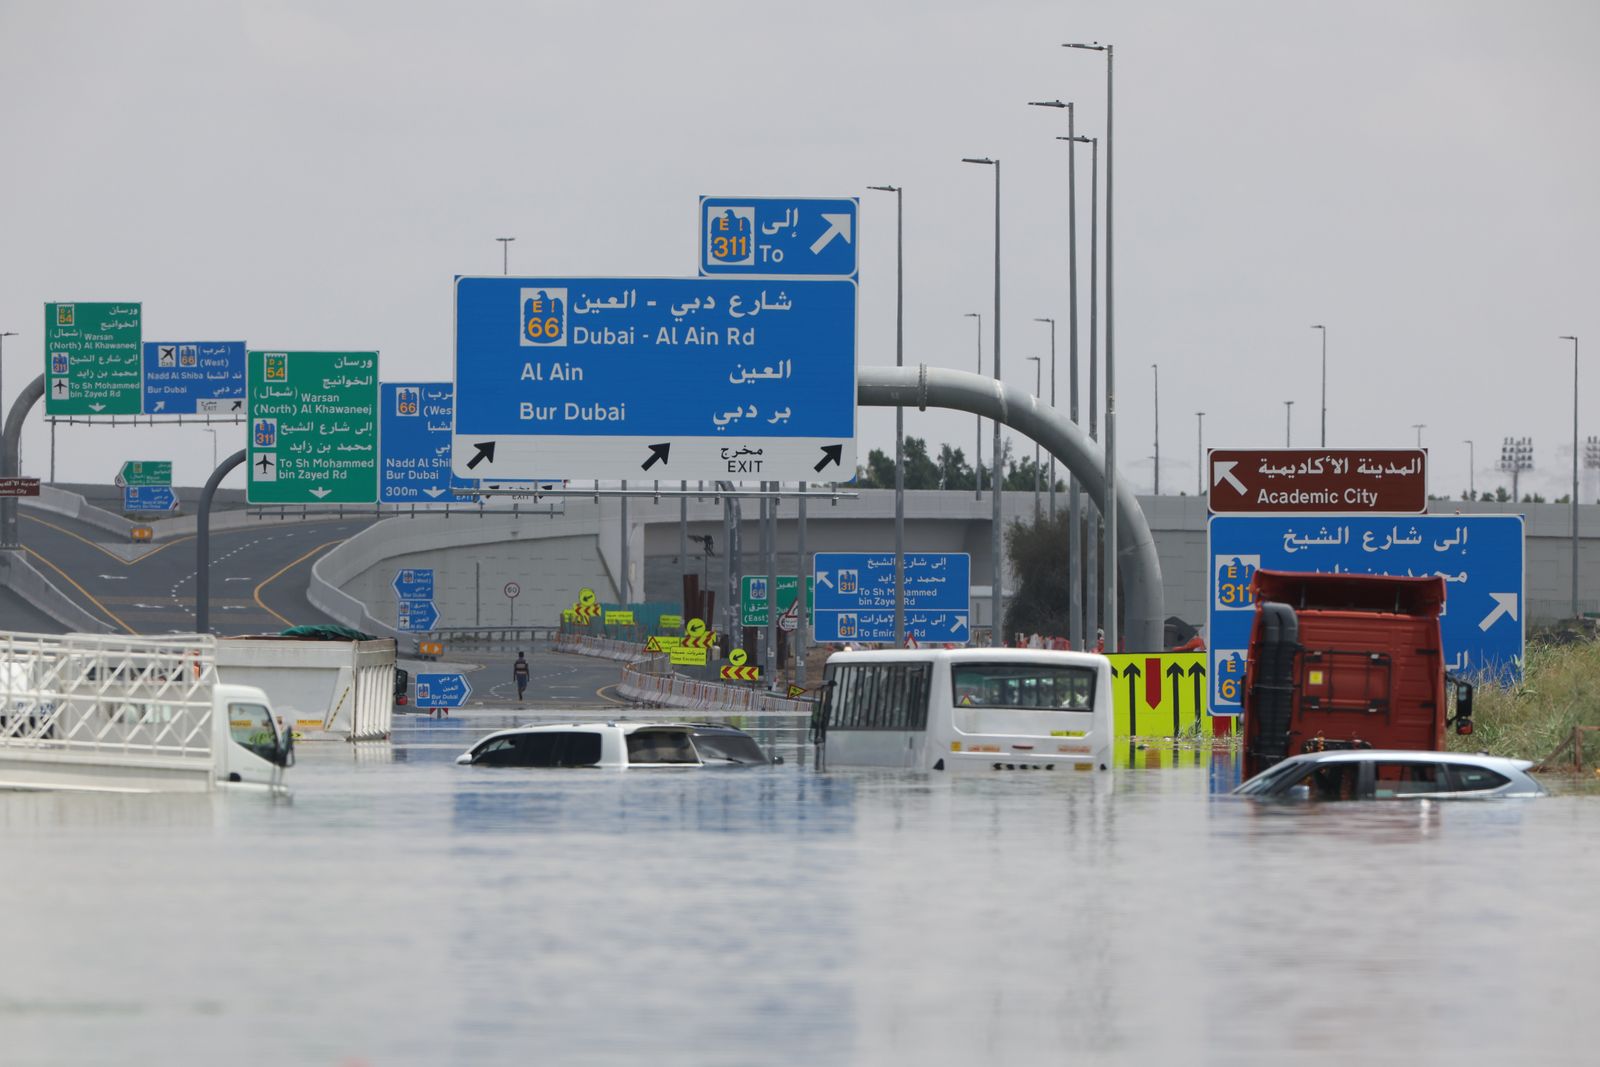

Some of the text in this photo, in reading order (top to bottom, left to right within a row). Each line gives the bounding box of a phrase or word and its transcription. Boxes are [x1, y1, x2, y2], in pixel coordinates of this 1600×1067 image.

[761, 207, 799, 238] إلى
[713, 236, 747, 258] 311
[759, 245, 785, 263] To
[573, 288, 636, 317] العين
[670, 292, 716, 322] دبي
[728, 291, 793, 317] شارع
[527, 316, 560, 339] 66
[573, 326, 635, 346] Dubai
[655, 327, 678, 346] Al
[684, 327, 719, 346] Ain
[727, 327, 755, 347] Rd
[50, 342, 82, 351] (North)
[95, 342, 137, 350] Khawaneej
[200, 358, 229, 368] (West)
[334, 356, 373, 369] ورسان
[148, 372, 170, 380] Nadd
[170, 372, 180, 380] Al
[266, 367, 284, 378] 54
[521, 362, 583, 381] Al Ain
[728, 358, 792, 385] العين
[322, 375, 373, 389] الخوانيج
[70, 390, 121, 398] bin Zayed Rd
[148, 386, 187, 394] Bur Dubai
[301, 393, 340, 402] Warsan
[254, 404, 372, 416] (North) Al Khawaneej
[400, 402, 416, 413] 66
[519, 402, 626, 421] Bur Dubai
[712, 404, 792, 431] بر دبي
[280, 422, 373, 436] إلى شارع الشيخ
[256, 432, 274, 444] 311
[290, 440, 373, 454] محمد بن زايد
[719, 445, 764, 460] مخرج
[280, 458, 374, 468] To Sh Mohammed
[386, 458, 429, 468] Nadd Al
[727, 460, 763, 473] EXIT
[1356, 456, 1422, 478] المدينة
[280, 470, 348, 481] bin Zayed Rd
[386, 470, 439, 480] Bur Dubai
[386, 486, 418, 496] 300m
[1257, 488, 1378, 506] Academic City
[1282, 525, 1468, 555] إلى شارع الشيخ
[931, 558, 946, 570] إلى
[840, 582, 855, 591] 311
[860, 588, 870, 596] To
[872, 587, 884, 596] Sh
[752, 589, 766, 597] 66
[858, 597, 916, 607] bin Zaye Rd
[930, 614, 946, 627] إلى
[840, 626, 855, 635] 611
[860, 628, 926, 637] To Rd
